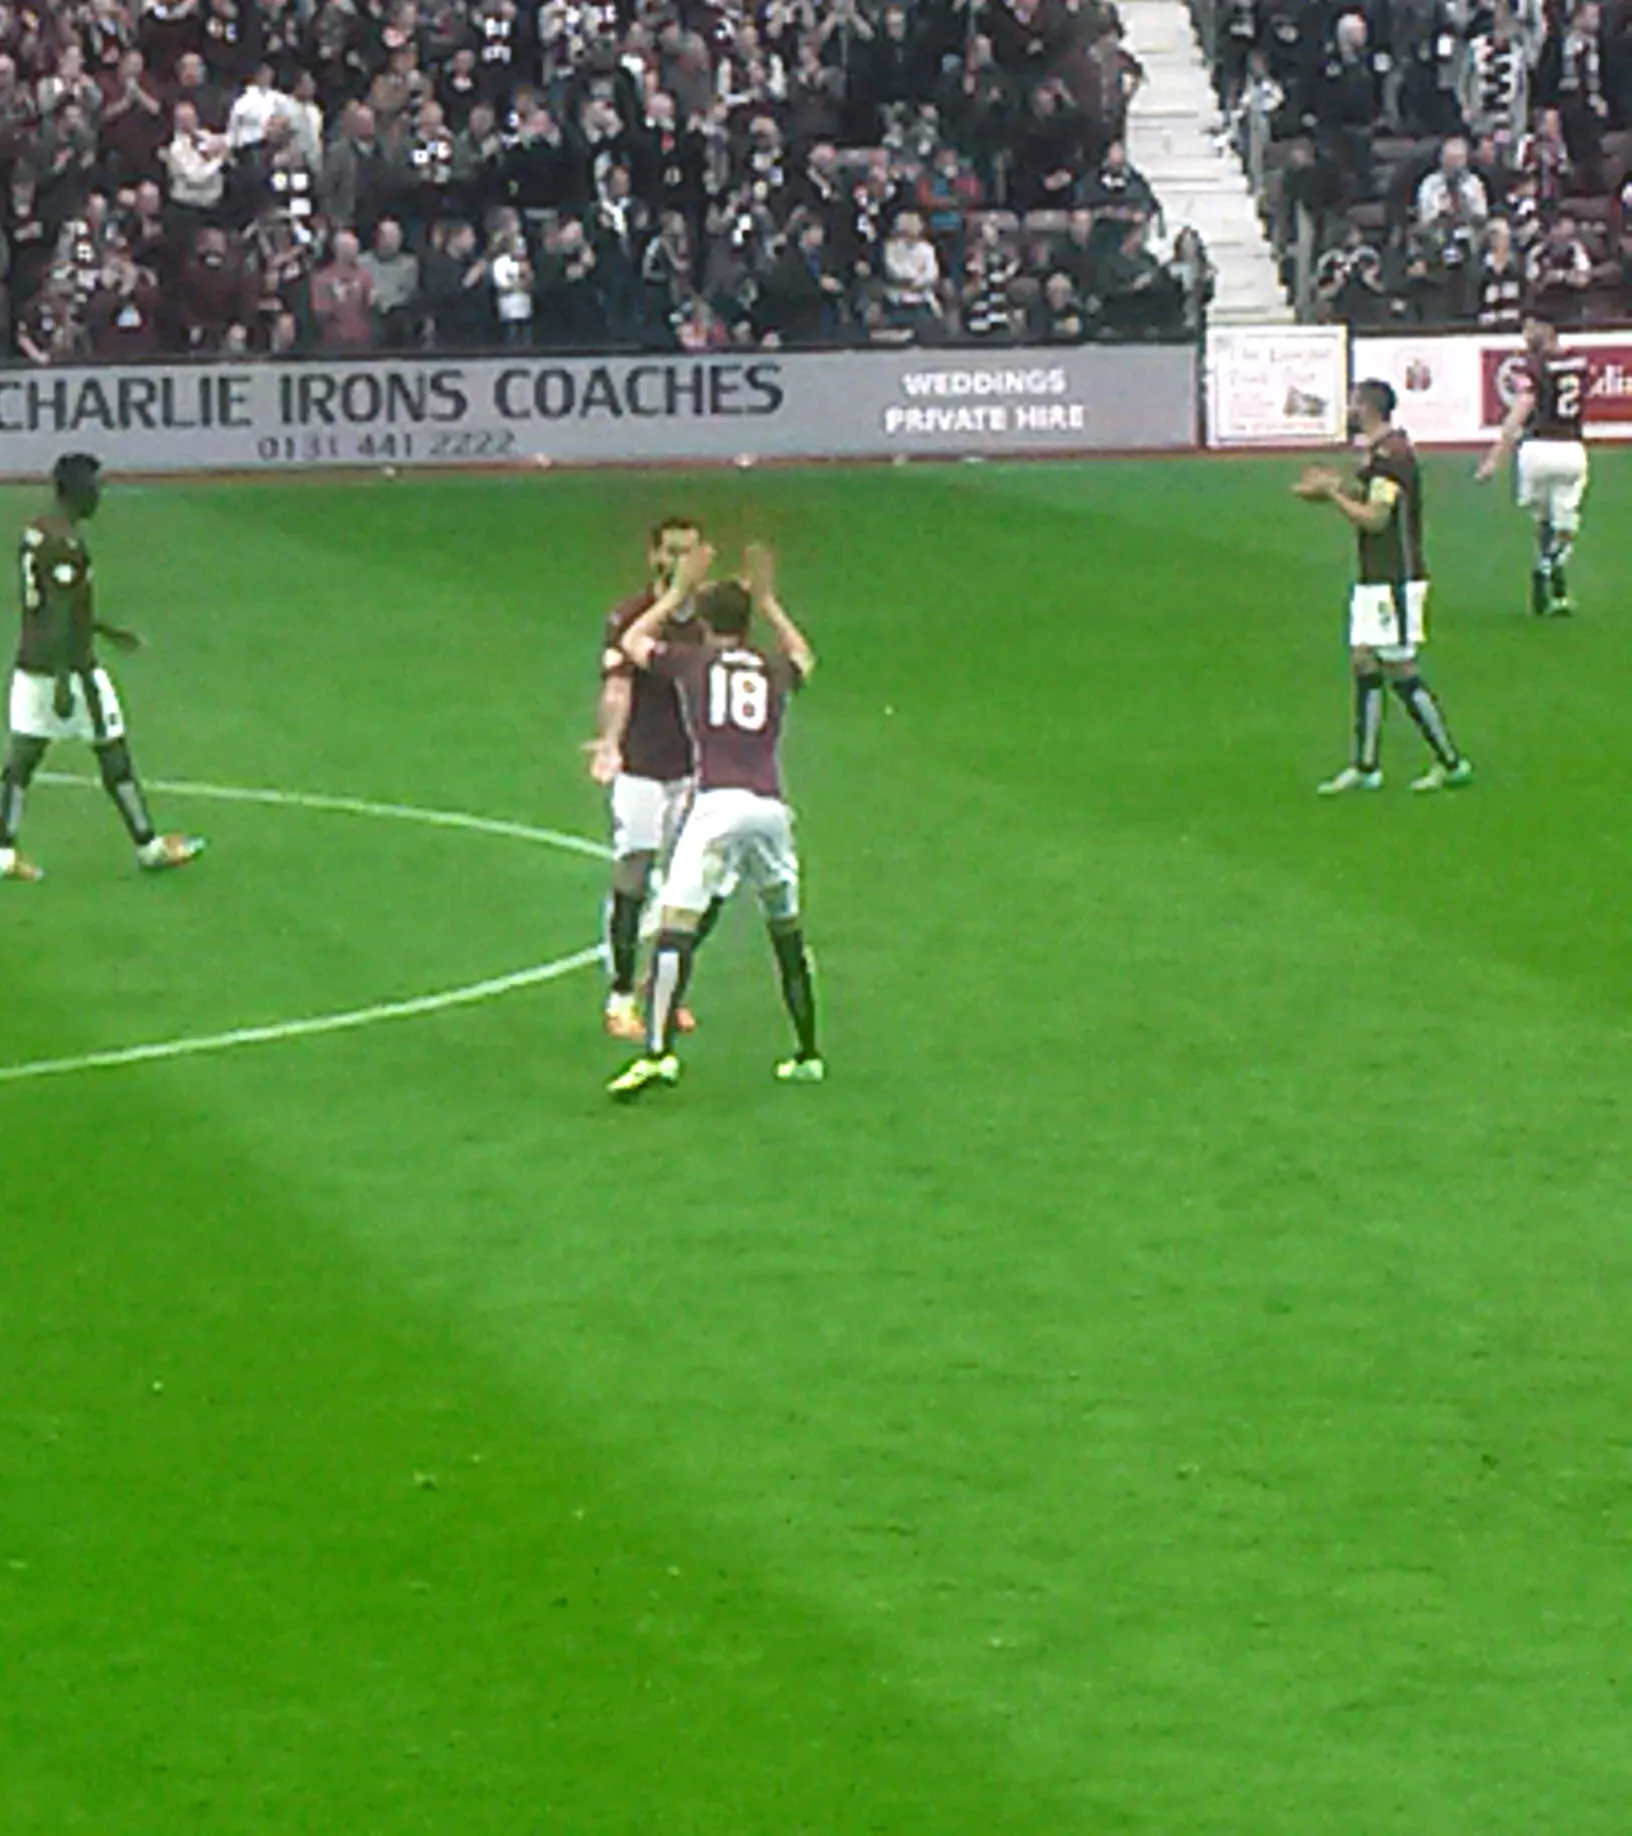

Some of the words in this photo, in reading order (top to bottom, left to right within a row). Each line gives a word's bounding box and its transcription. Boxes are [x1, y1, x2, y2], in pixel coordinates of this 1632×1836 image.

[280, 369, 468, 426] IRONS
[492, 361, 785, 420] COACHES
[900, 367, 1067, 396] WEDDINGS
[1557, 373, 1581, 418] 2
[884, 405, 1008, 433] PRIVATE
[1015, 403, 1085, 431] HIRE
[257, 436, 339, 461] 0131
[356, 432, 413, 459] 441
[429, 428, 517, 456] 2222
[708, 661, 769, 731] 18
